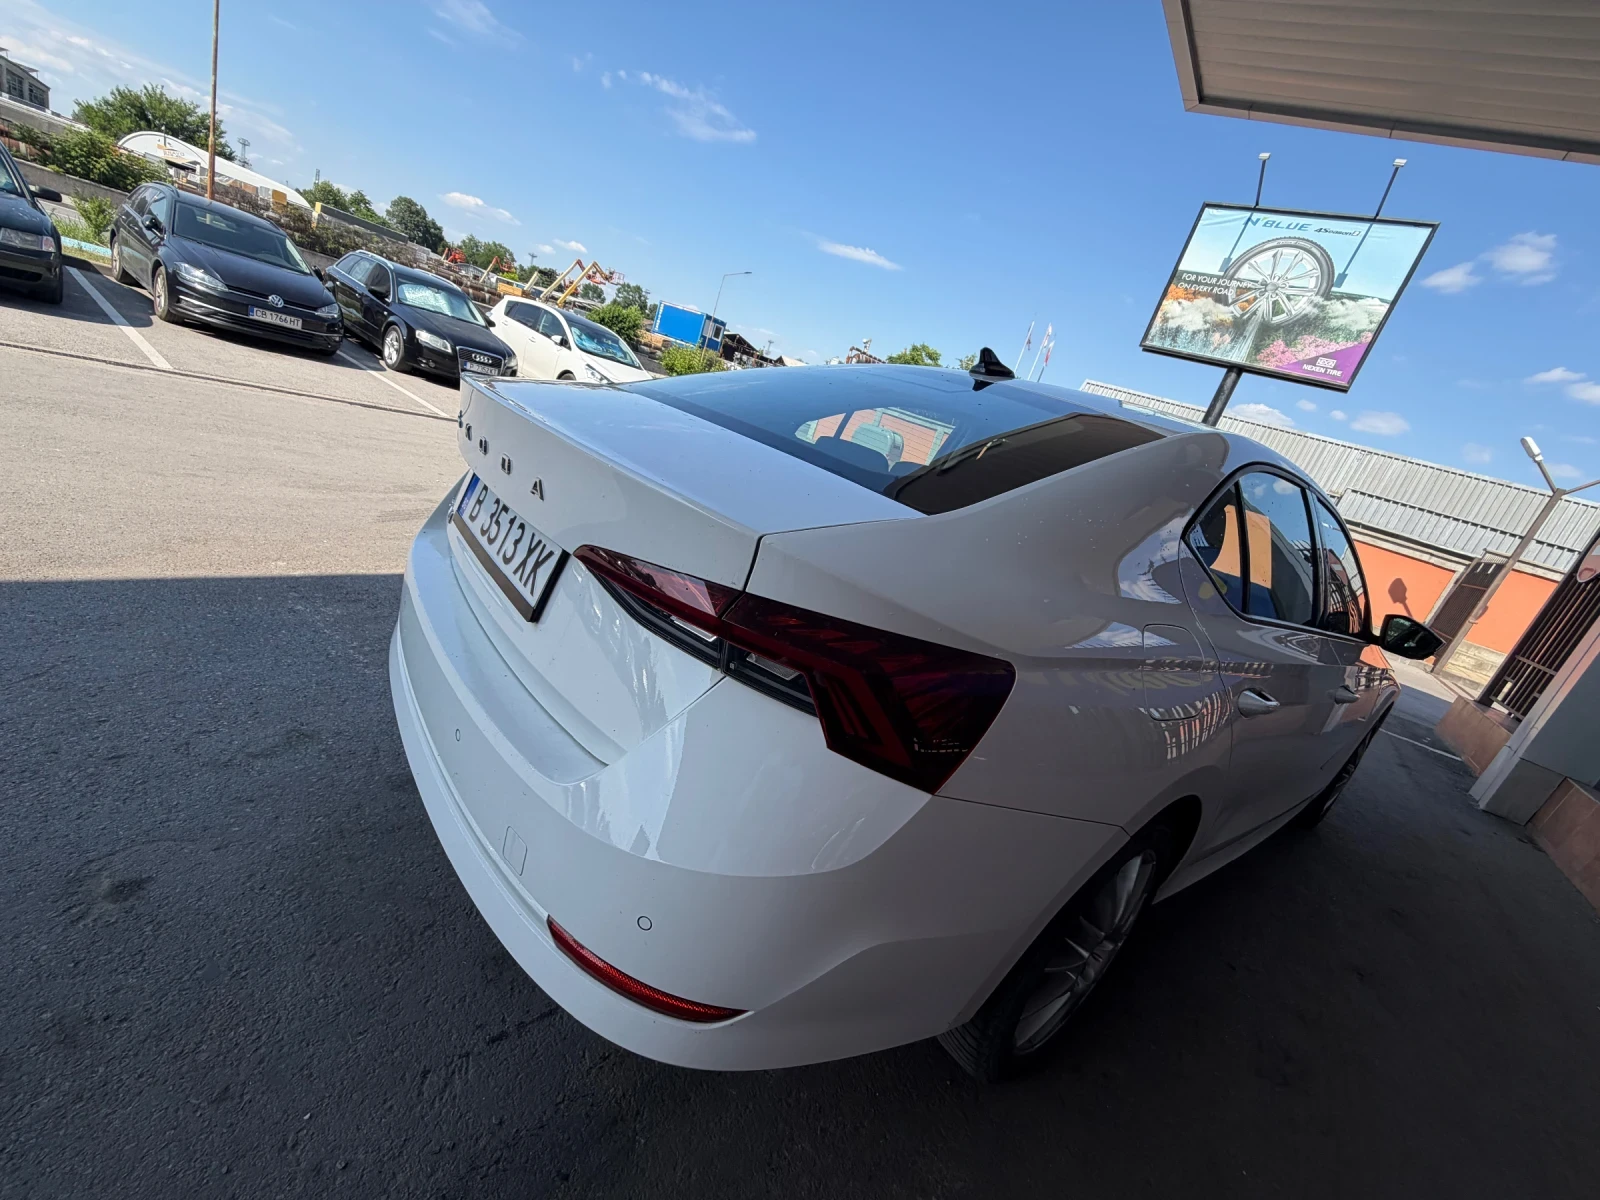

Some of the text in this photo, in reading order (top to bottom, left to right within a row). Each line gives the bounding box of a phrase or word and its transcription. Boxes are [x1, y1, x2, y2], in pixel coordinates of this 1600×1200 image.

[1177, 282, 1235, 296] ON EVERY ROAD
[1181, 272, 1253, 289] FOR YOUR JOURNEY
[255, 309, 301, 327] CB 1766 HT
[1302, 363, 1343, 377] NEXEN TIRE
[468, 483, 555, 597] B 3513 XK
